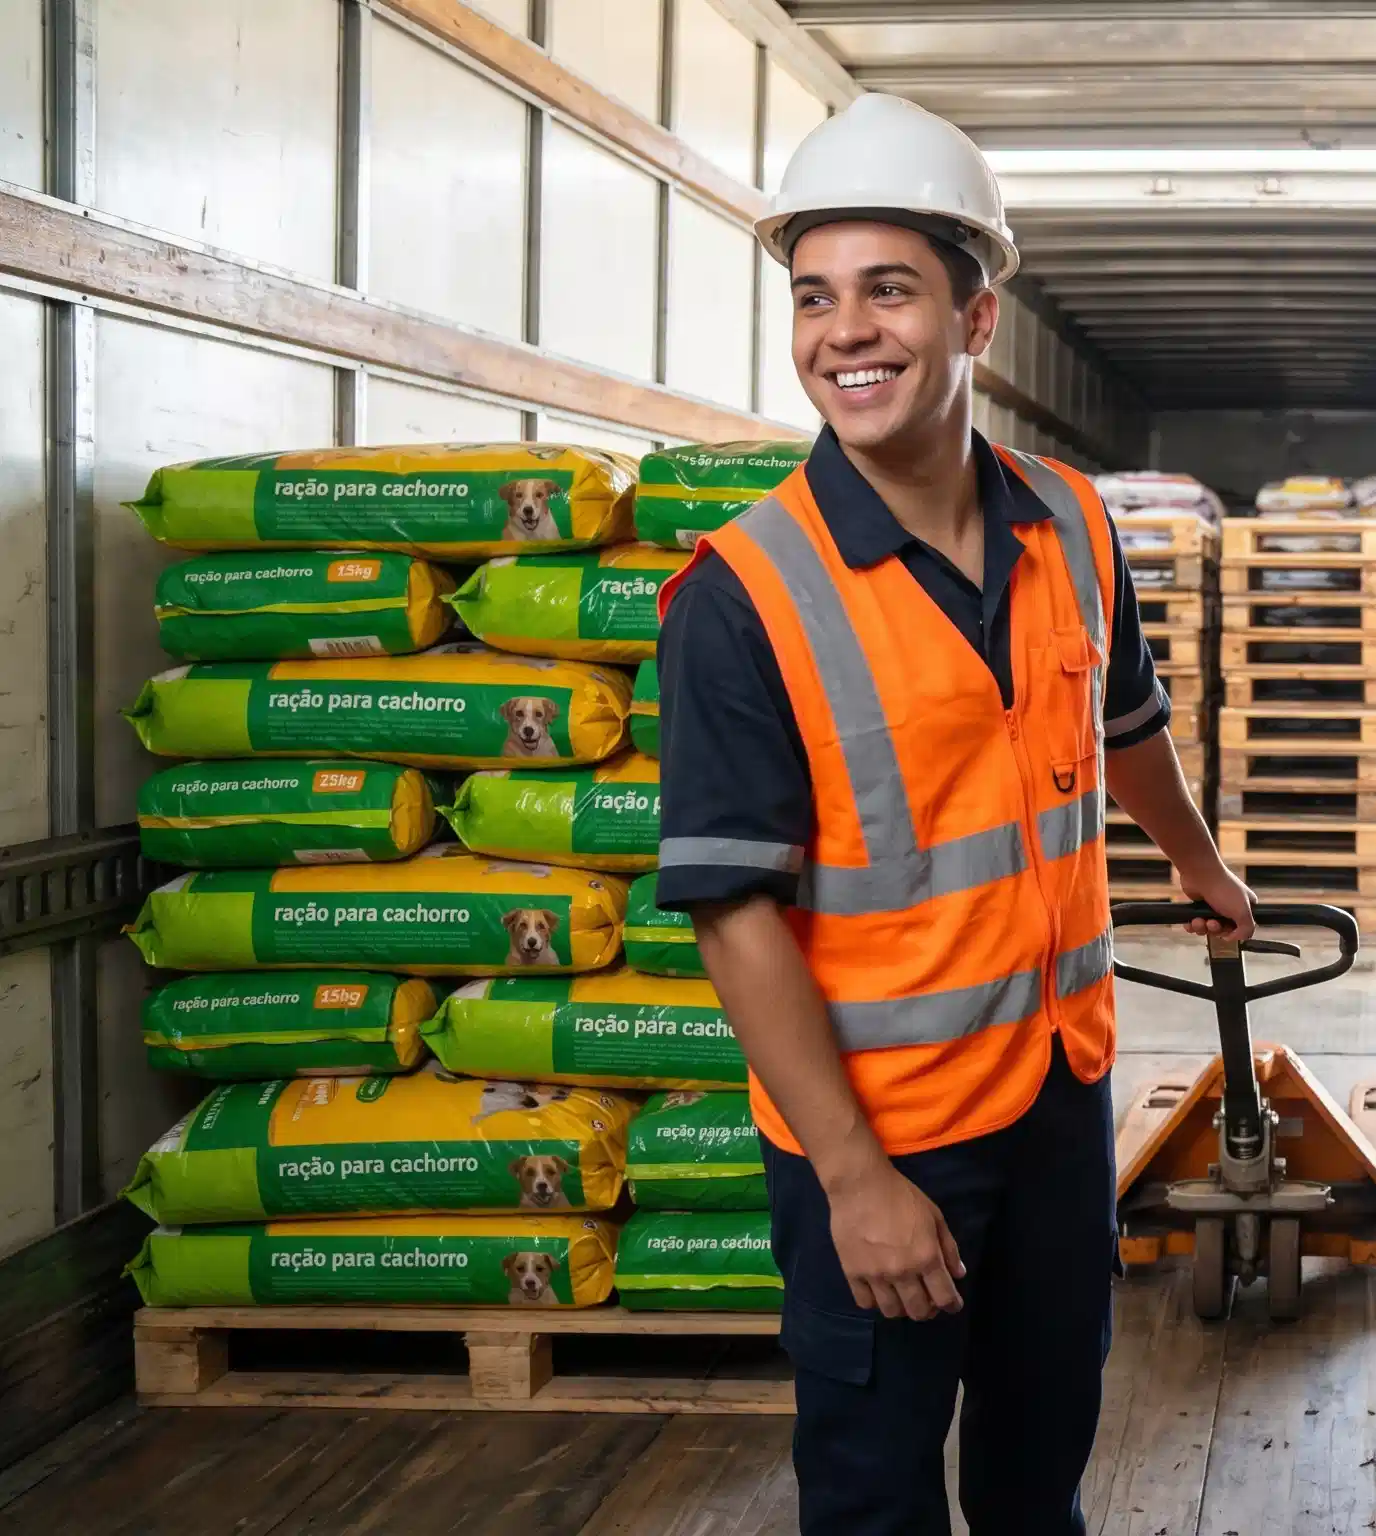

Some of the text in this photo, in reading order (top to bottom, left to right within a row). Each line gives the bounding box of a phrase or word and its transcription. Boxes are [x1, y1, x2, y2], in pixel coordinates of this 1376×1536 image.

[274, 478, 469, 501] ração para cachorro
[185, 565, 313, 585] ração para cachorro
[600, 576, 658, 600] ração
[269, 688, 466, 713] ração para cachorro
[171, 776, 299, 796] ração para cachorro
[318, 772, 358, 788] 25kg
[594, 790, 649, 814] ração
[274, 901, 470, 926] ração para cachorro
[173, 992, 300, 1013] ração para cachorro
[575, 1014, 630, 1037] ração
[634, 1019, 677, 1038] para
[656, 1124, 696, 1140] ração
[279, 1153, 479, 1181] ração para cachorro
[647, 1236, 684, 1253] ração
[687, 1238, 718, 1252] para
[271, 1247, 469, 1273] ração para cachorro
